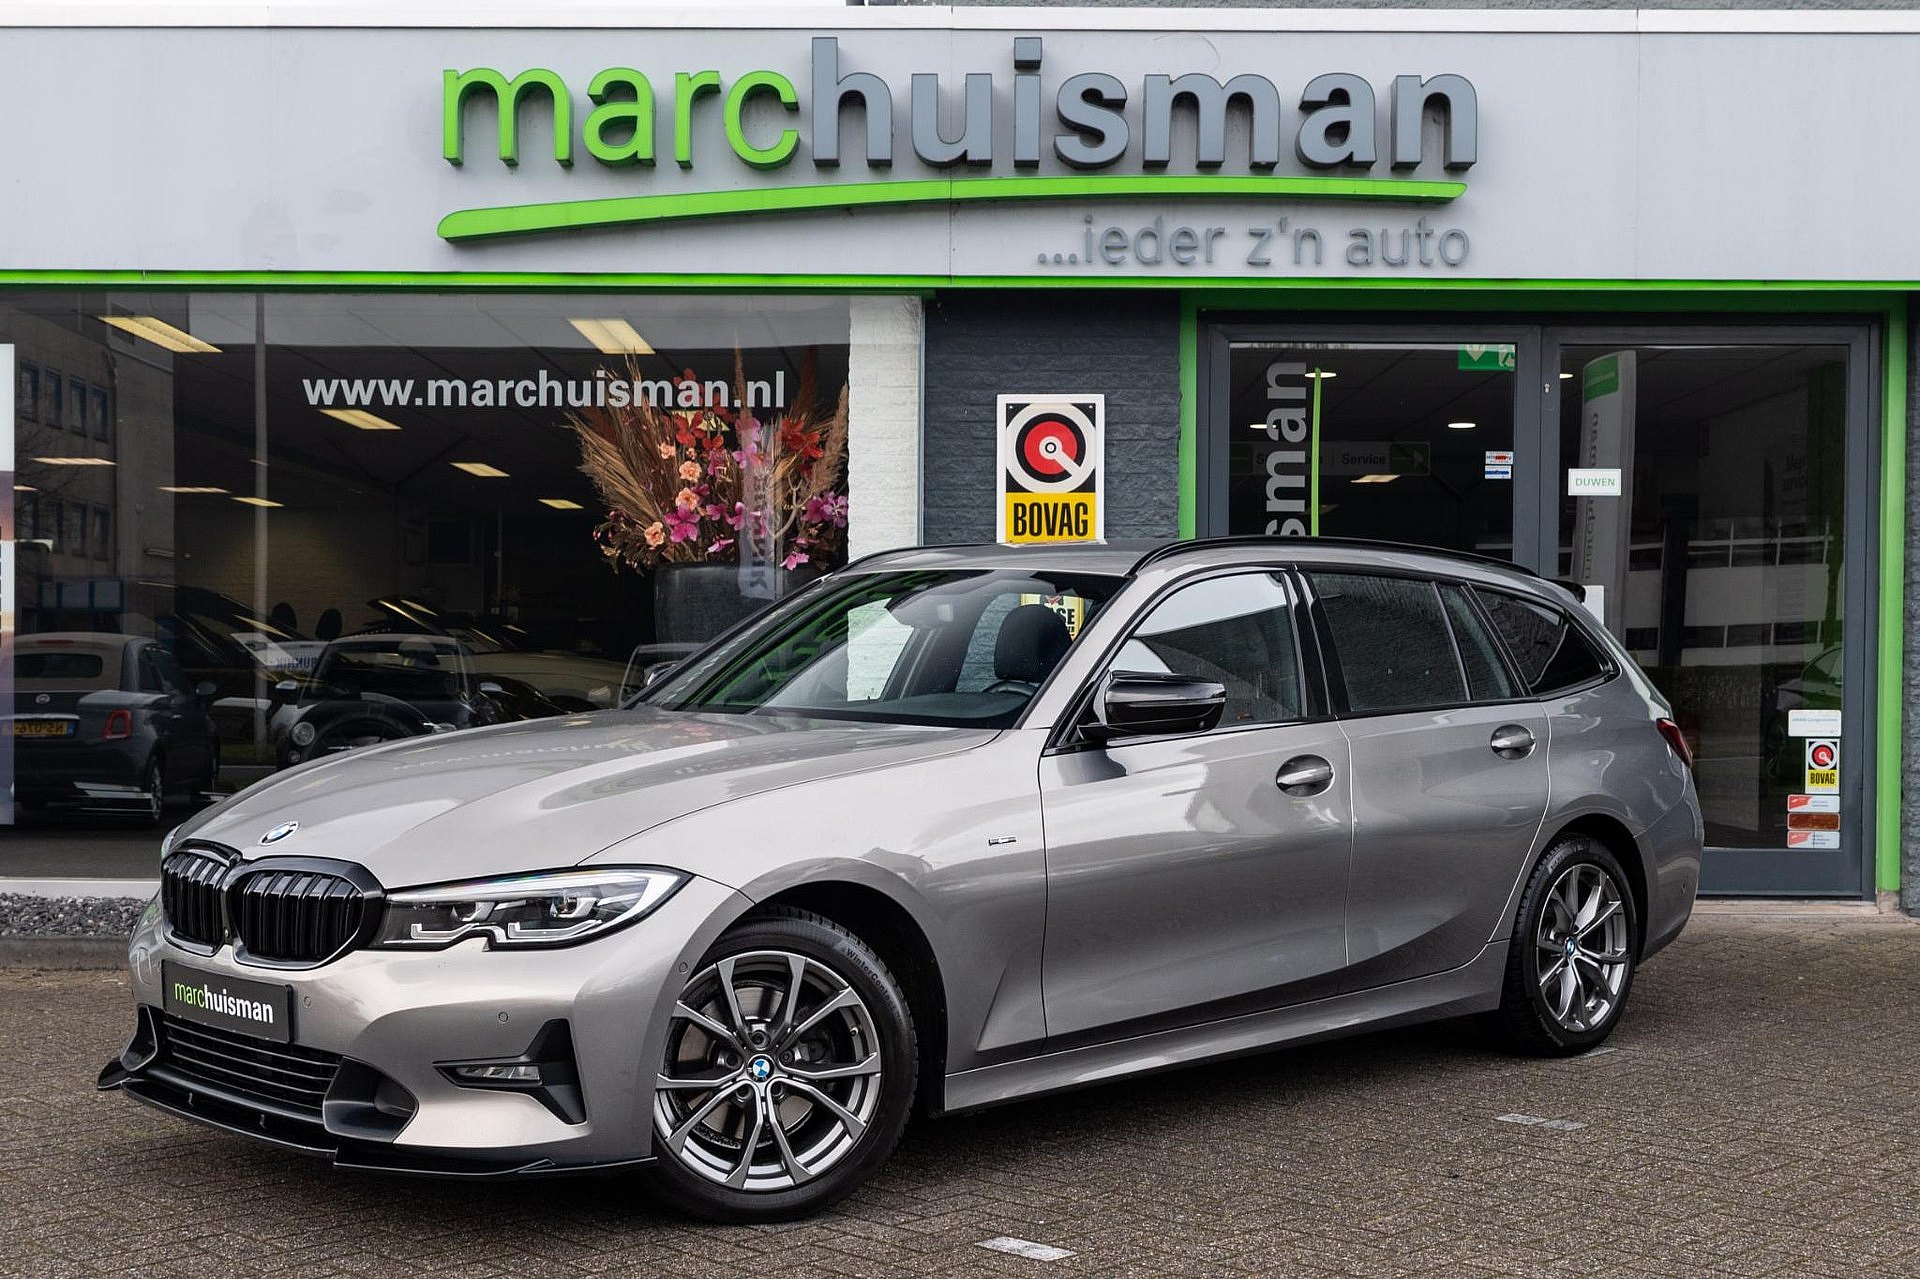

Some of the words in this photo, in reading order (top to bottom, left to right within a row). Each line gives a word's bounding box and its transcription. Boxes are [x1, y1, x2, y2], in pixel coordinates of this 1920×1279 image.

[442, 37, 1478, 170] marchuisman
[1247, 217, 1322, 265] z'n
[1346, 217, 1470, 265] auto
[302, 370, 785, 408] www.marchuisman.nl
[1575, 478, 1616, 486] DUWEN
[1013, 502, 1088, 537] BOVAG
[1810, 773, 1835, 784] BOVAG
[174, 981, 274, 1024] marchuisman
